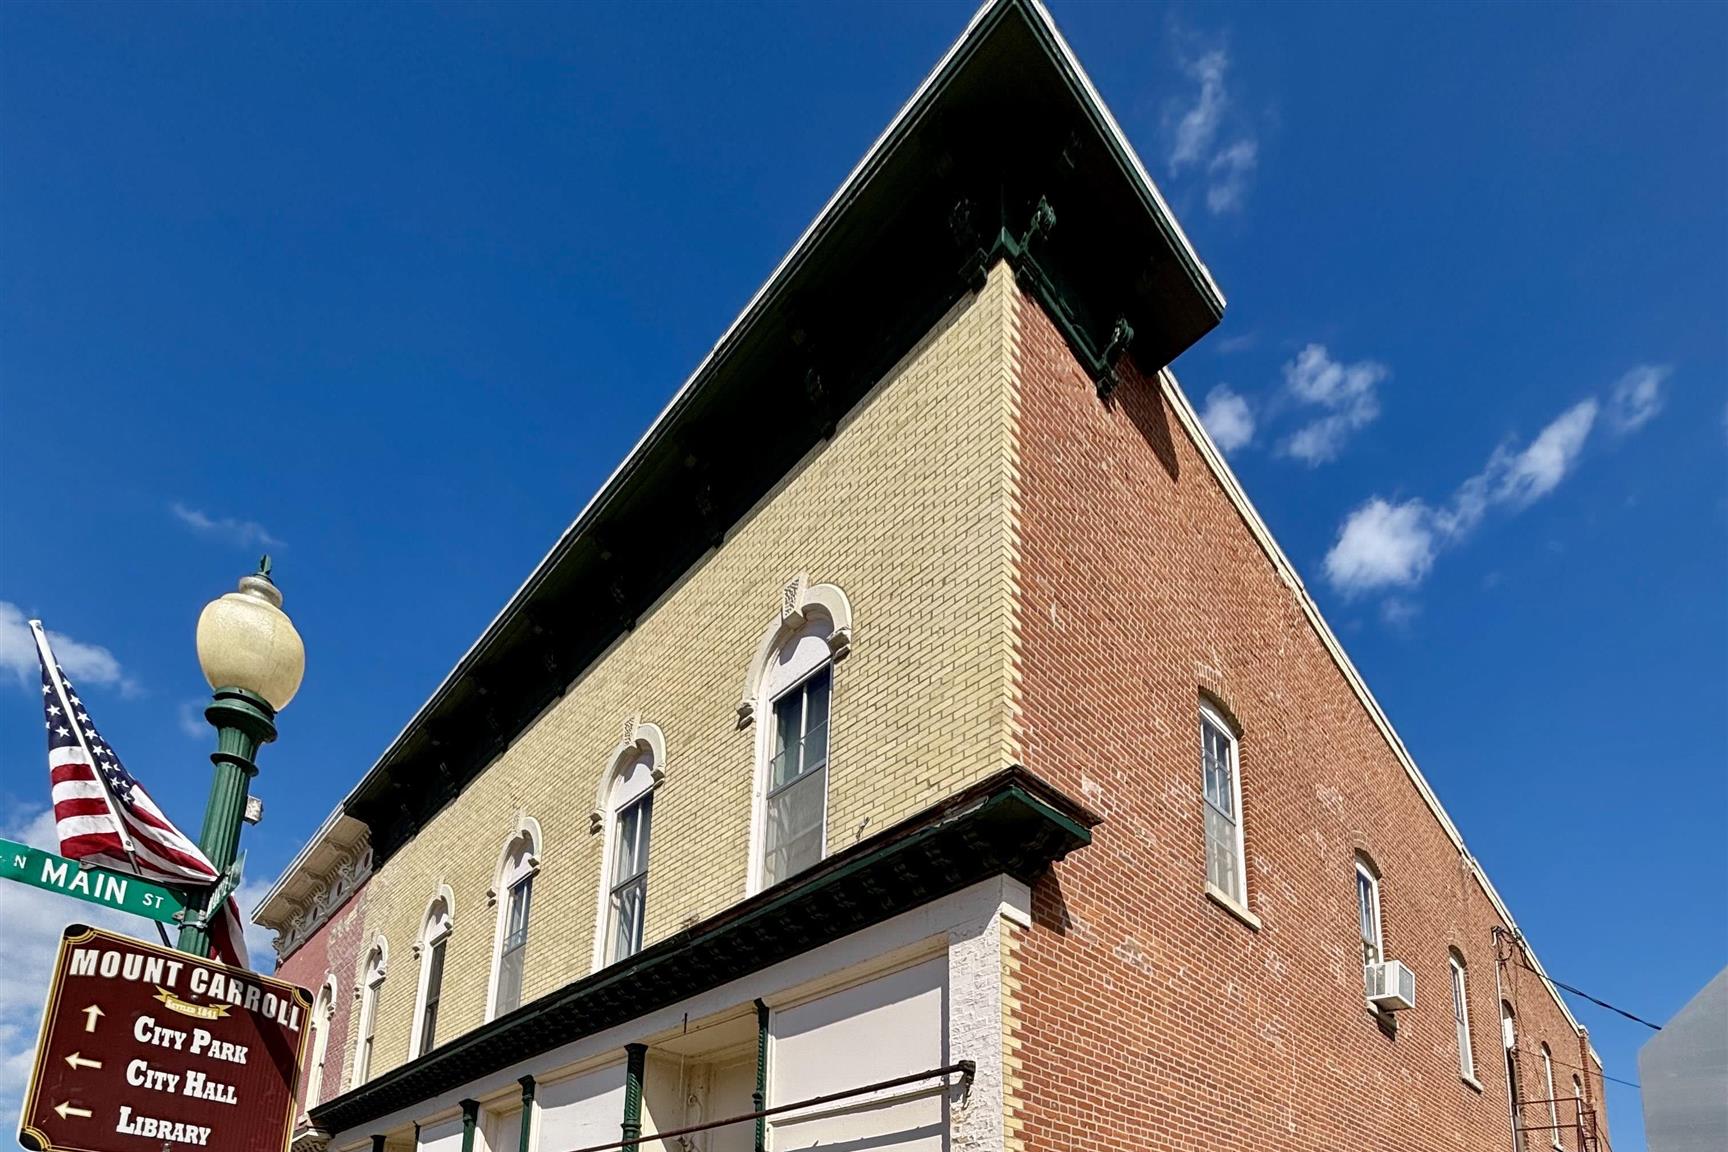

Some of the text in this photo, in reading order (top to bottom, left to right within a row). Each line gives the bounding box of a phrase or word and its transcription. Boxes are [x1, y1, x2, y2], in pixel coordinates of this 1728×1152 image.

[13, 854, 164, 909] N MAIN ST
[69, 948, 300, 1032] MOUNT CARROLL
[133, 1015, 249, 1065] CITY PARK
[126, 1058, 238, 1105] CITY HALL
[116, 1105, 212, 1146] LIBRARY
